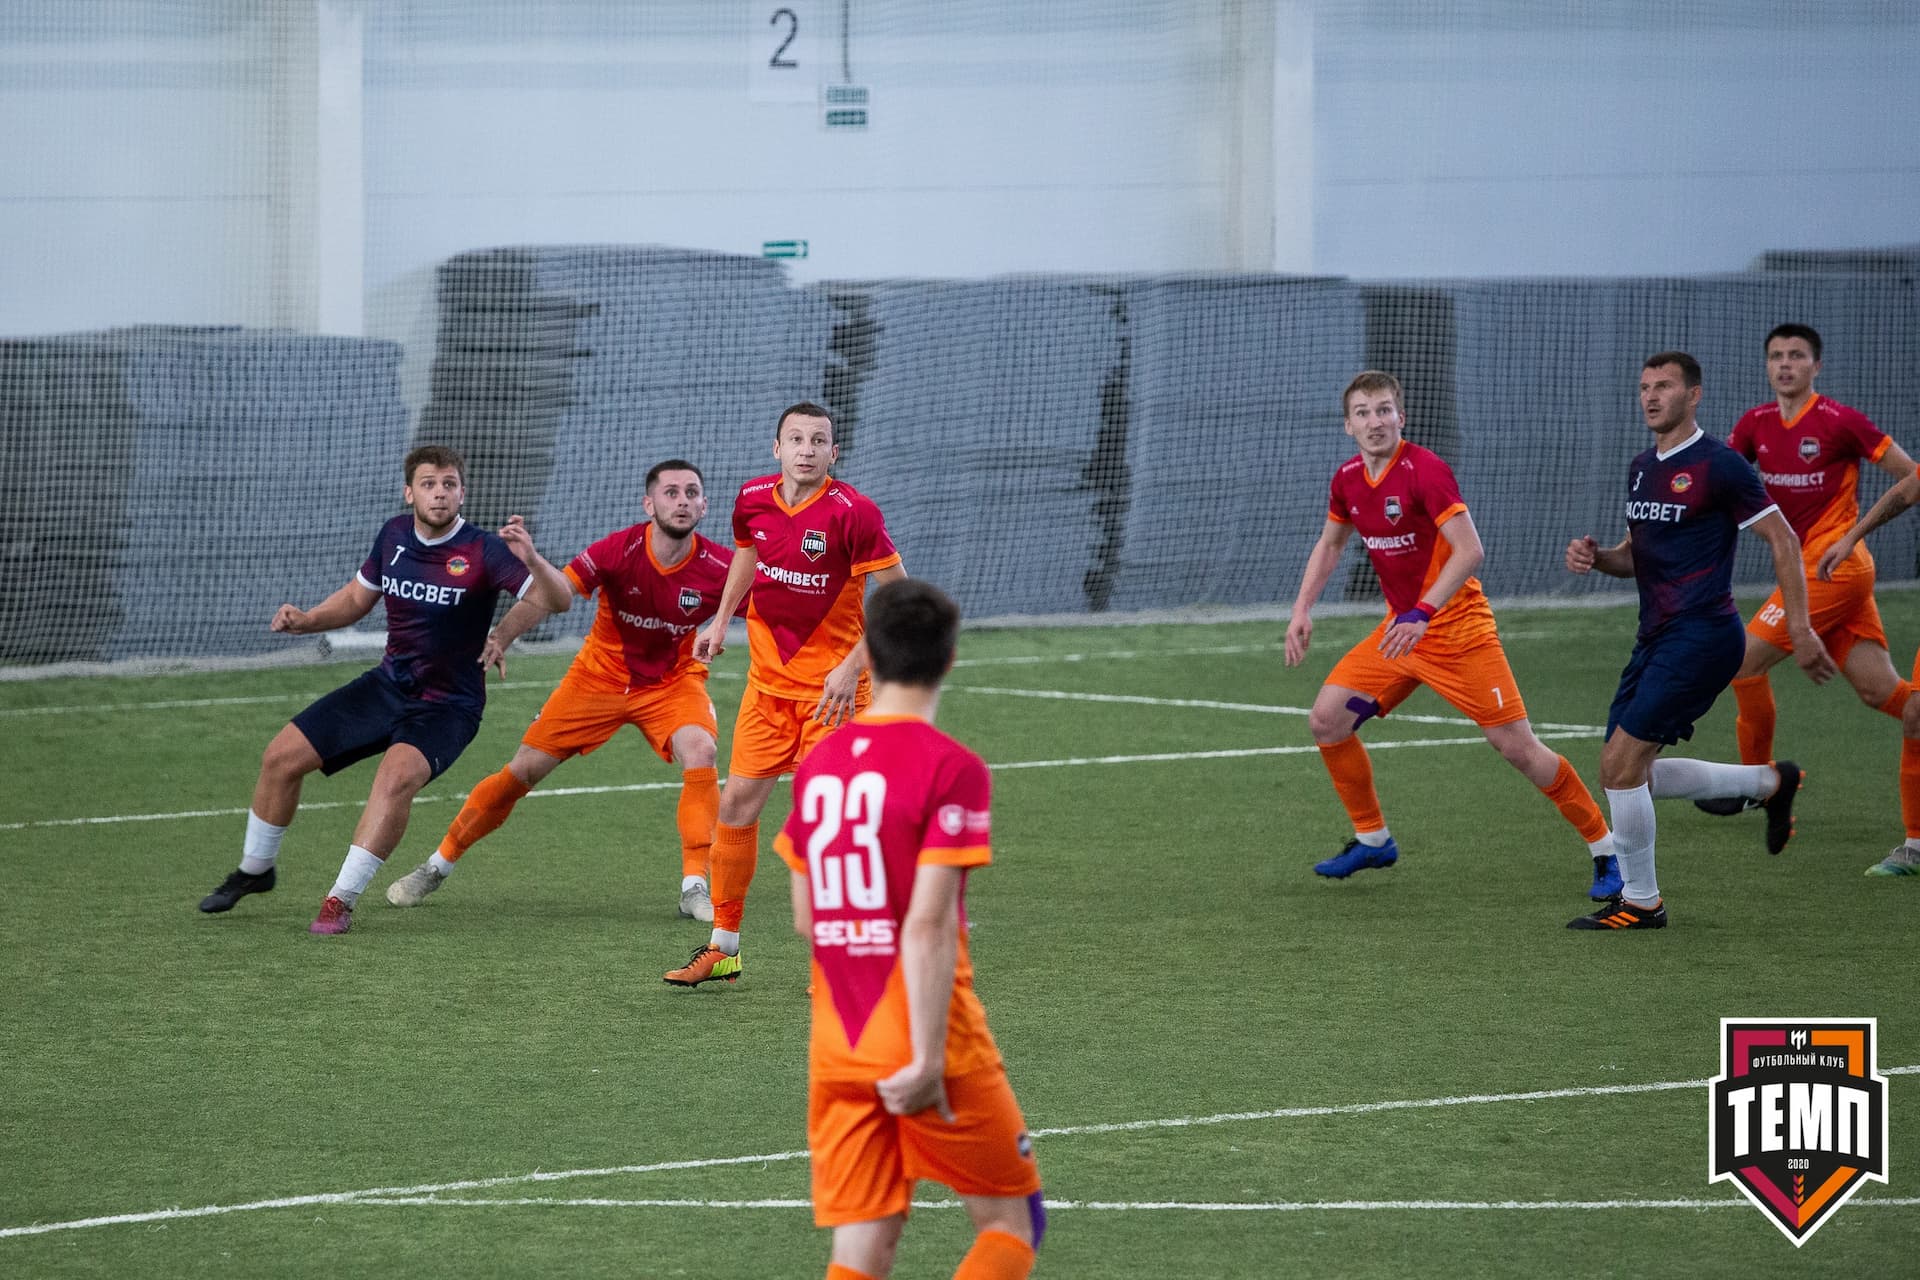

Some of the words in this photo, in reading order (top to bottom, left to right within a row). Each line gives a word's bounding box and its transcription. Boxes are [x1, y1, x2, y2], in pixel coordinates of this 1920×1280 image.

[769, 8, 798, 69] 2
[1633, 471, 1643, 491] 3
[1626, 501, 1687, 522] АССВЕТ
[390, 545, 405, 566] 7
[804, 538, 824, 552] ТЕМП
[381, 574, 467, 606] РАССВЕТ
[1491, 687, 1503, 710] 1
[802, 771, 887, 910] 23
[814, 919, 894, 946] SEUS
